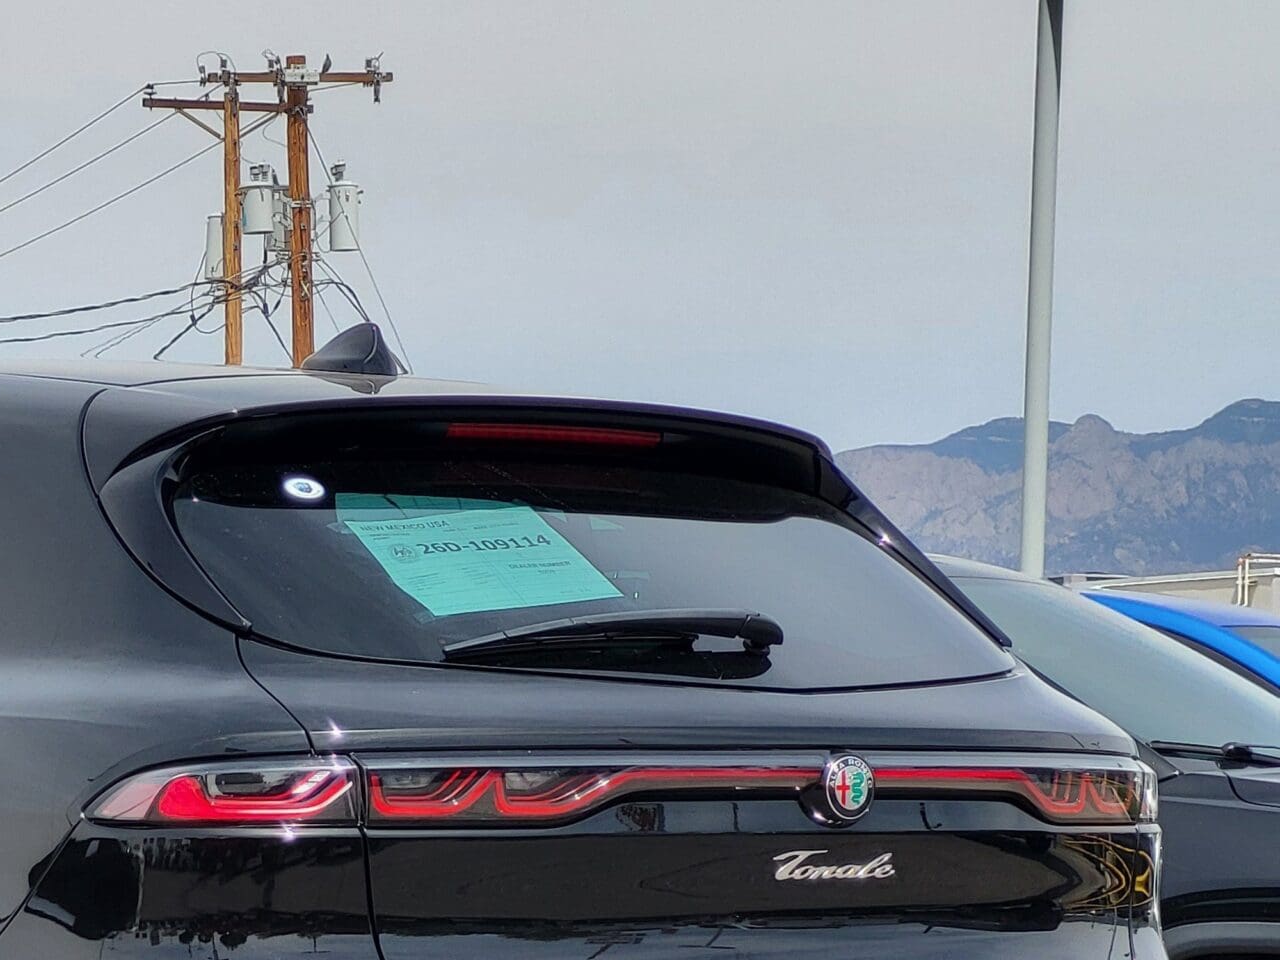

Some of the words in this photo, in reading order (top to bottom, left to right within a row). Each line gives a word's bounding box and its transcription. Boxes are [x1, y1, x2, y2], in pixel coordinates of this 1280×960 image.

[386, 521, 424, 531] MEXICO
[426, 519, 450, 529] USA
[416, 534, 552, 555] 26D-109114
[773, 850, 896, 880] Tonale
